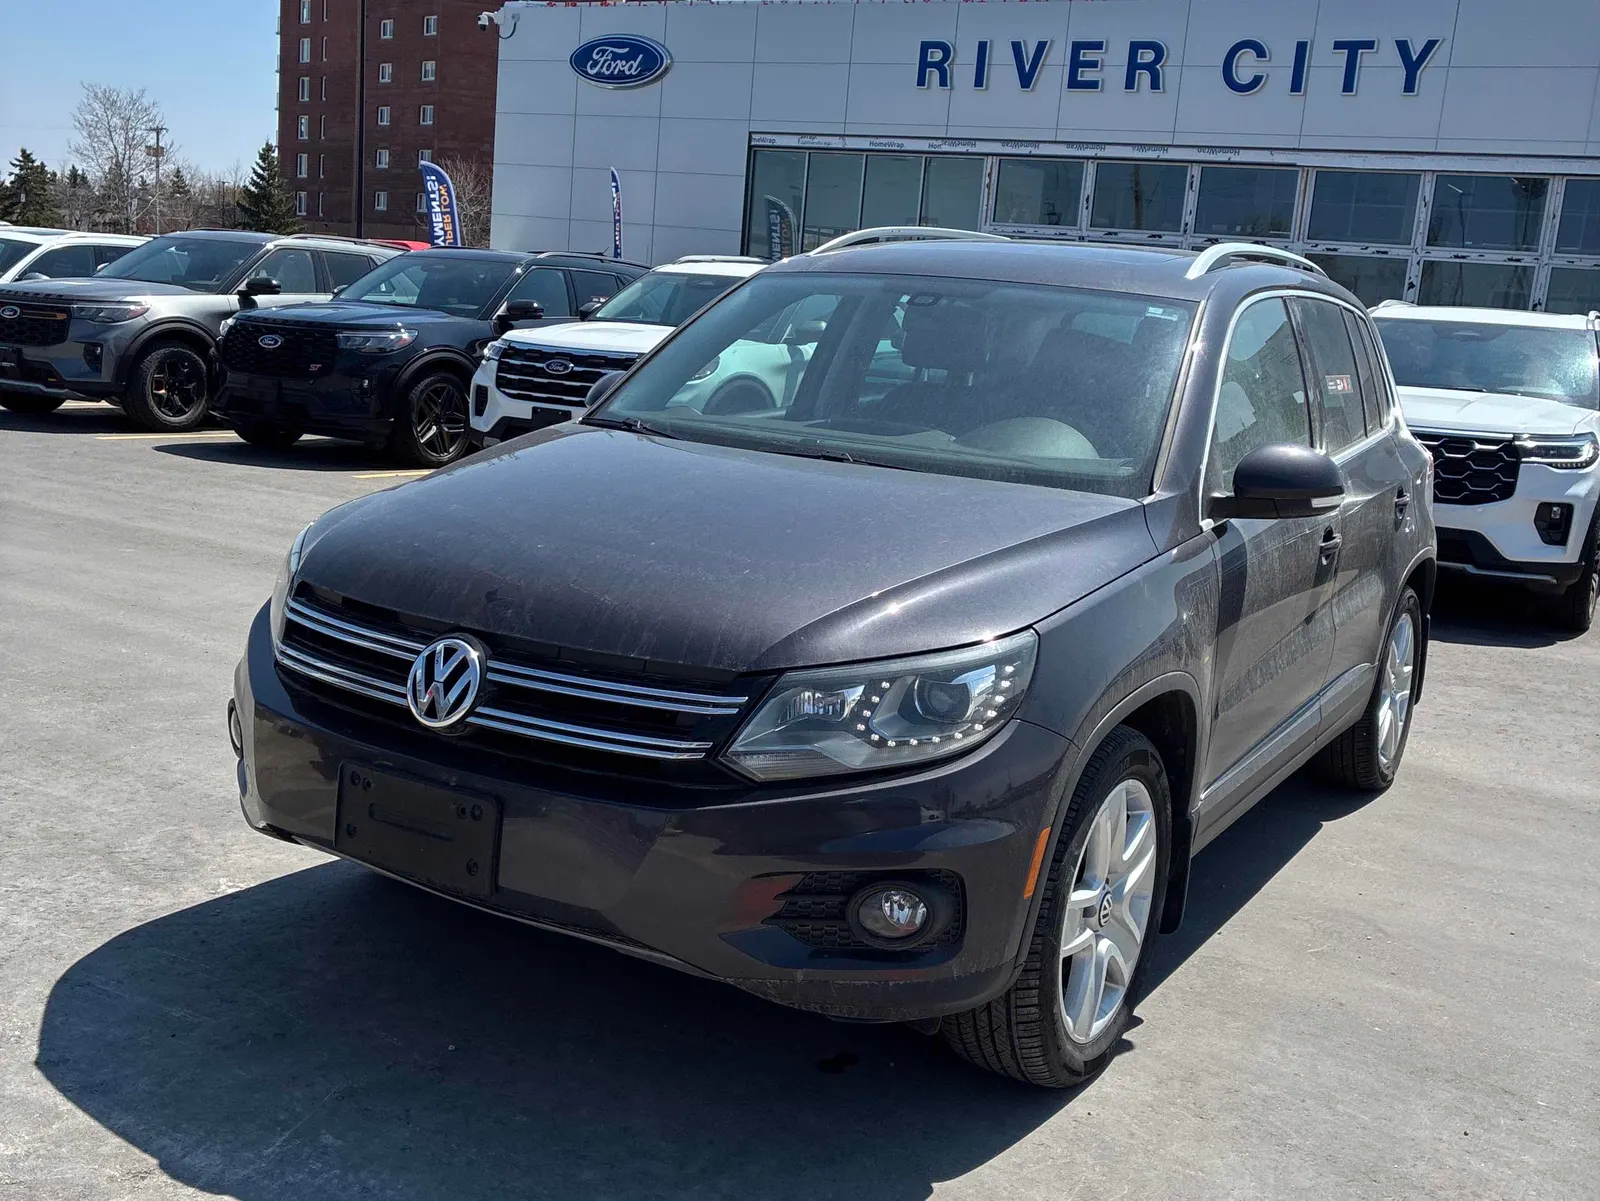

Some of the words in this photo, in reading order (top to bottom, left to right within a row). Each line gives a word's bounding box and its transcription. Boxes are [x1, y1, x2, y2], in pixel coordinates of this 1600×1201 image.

[586, 45, 644, 76] Ford
[915, 38, 1168, 92] RIVER
[1221, 37, 1444, 97] CITY
[308, 363, 322, 371] ST
